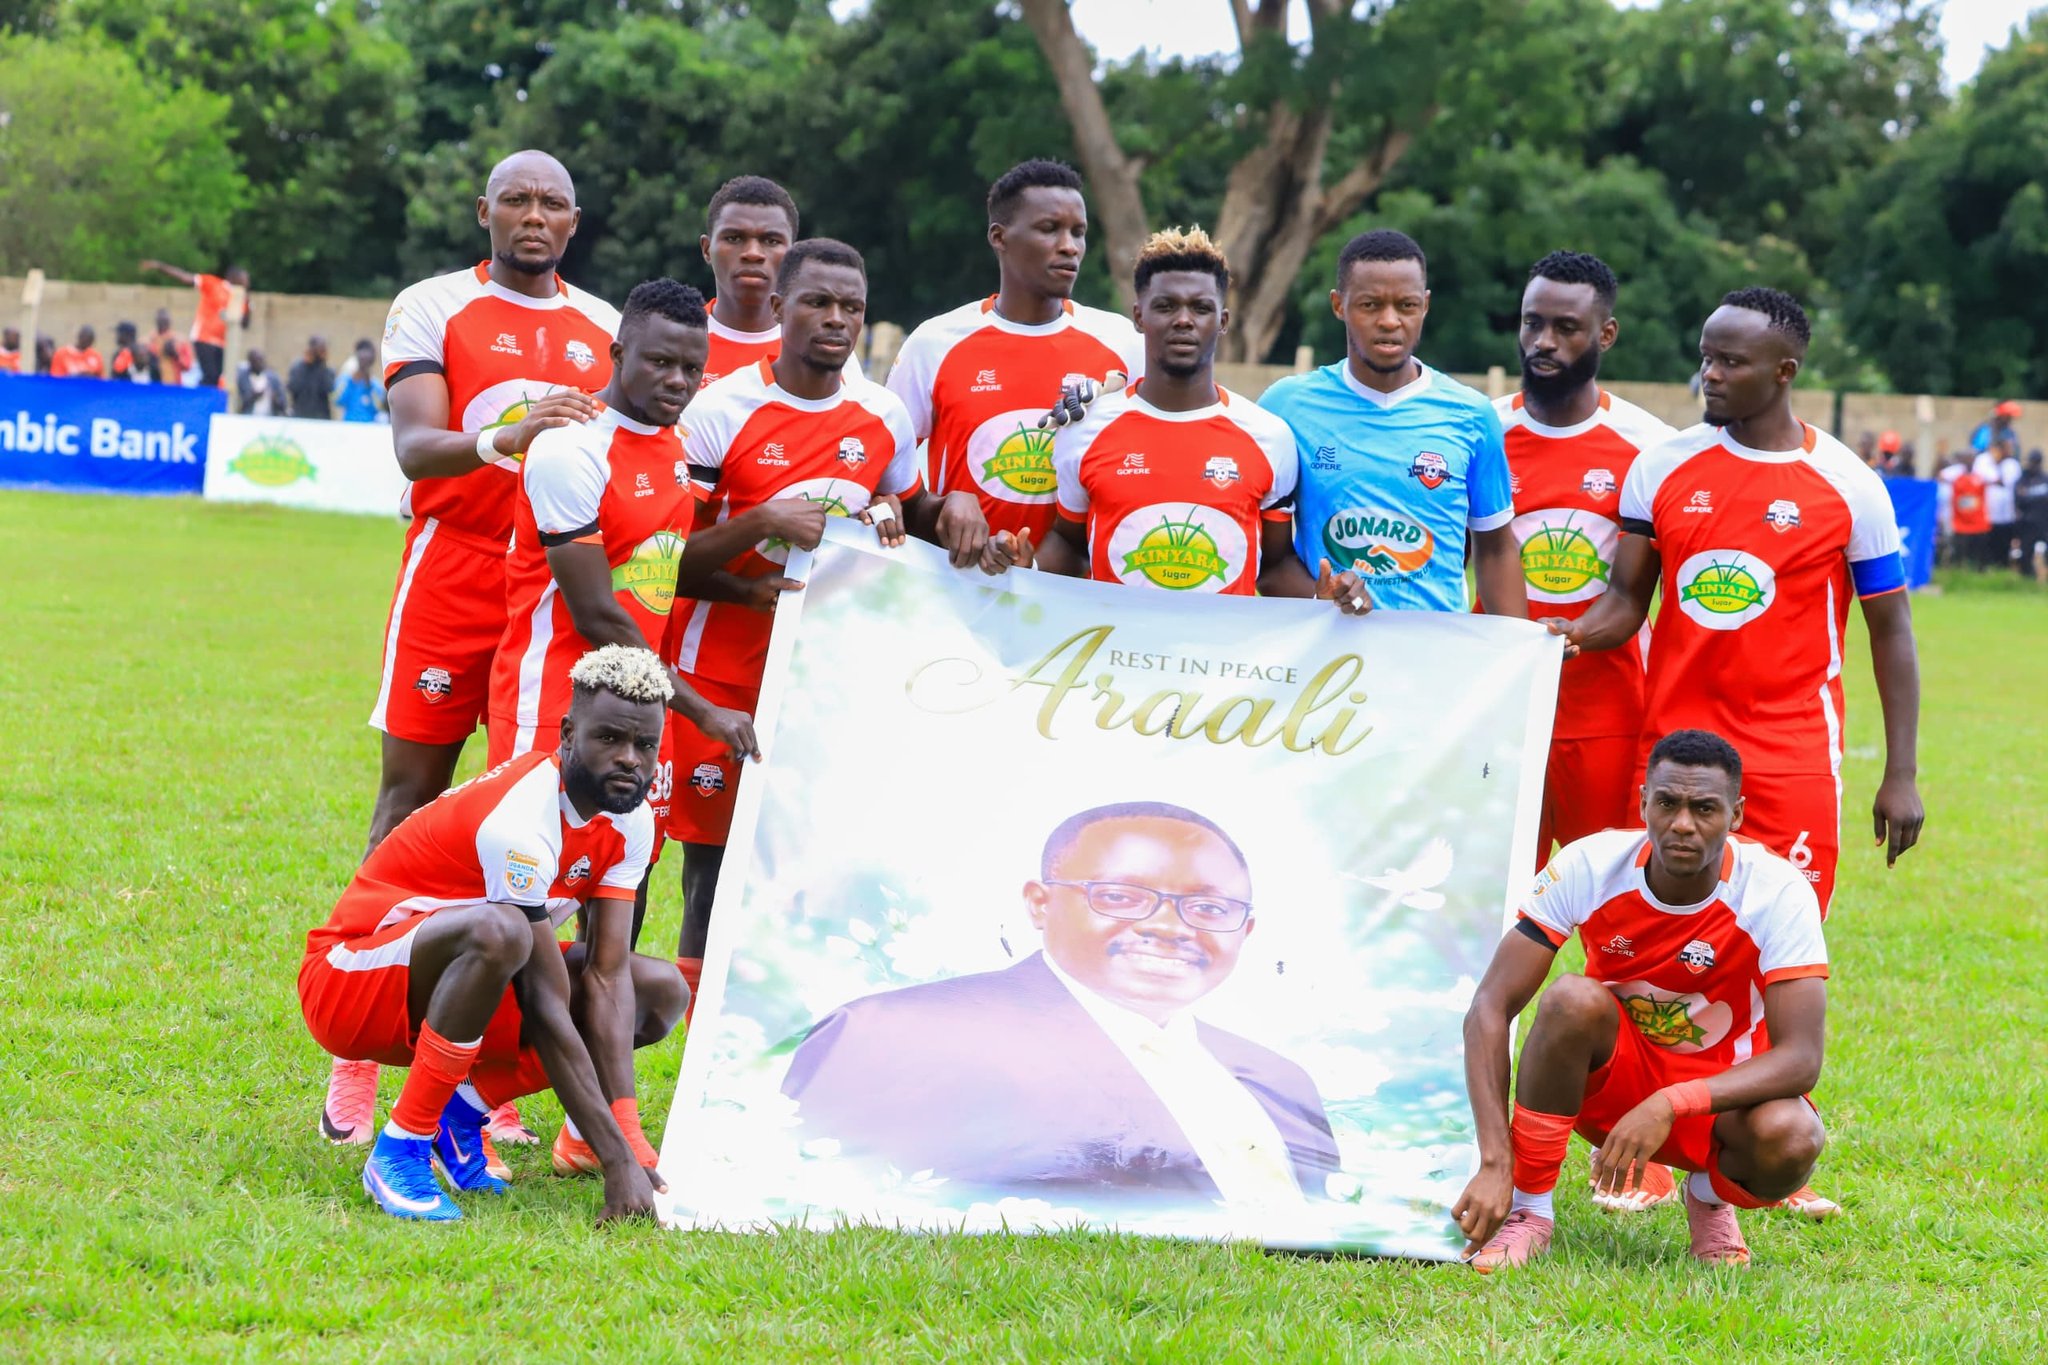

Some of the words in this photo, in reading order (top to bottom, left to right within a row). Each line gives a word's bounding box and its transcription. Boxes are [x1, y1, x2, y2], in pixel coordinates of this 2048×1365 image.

[490, 345, 523, 356] GOFERE
[971, 384, 1002, 392] GOFERE
[91, 418, 198, 464] Bank
[757, 458, 790, 466] GOFERE
[991, 455, 1056, 474] KINYA
[1020, 475, 1048, 485] Sugar
[1335, 517, 1421, 543] JONARD
[1133, 549, 1219, 570] KINYARA
[1162, 569, 1191, 579] Sugar
[1544, 573, 1571, 584] Sugar
[1109, 649, 1171, 671] REST
[1179, 657, 1209, 676] IN
[1220, 661, 1298, 684] PEACE
[1006, 625, 1373, 756] Araali
[647, 760, 673, 802] 38
[1788, 830, 1813, 870] 6
[508, 861, 535, 872] UGANDA
